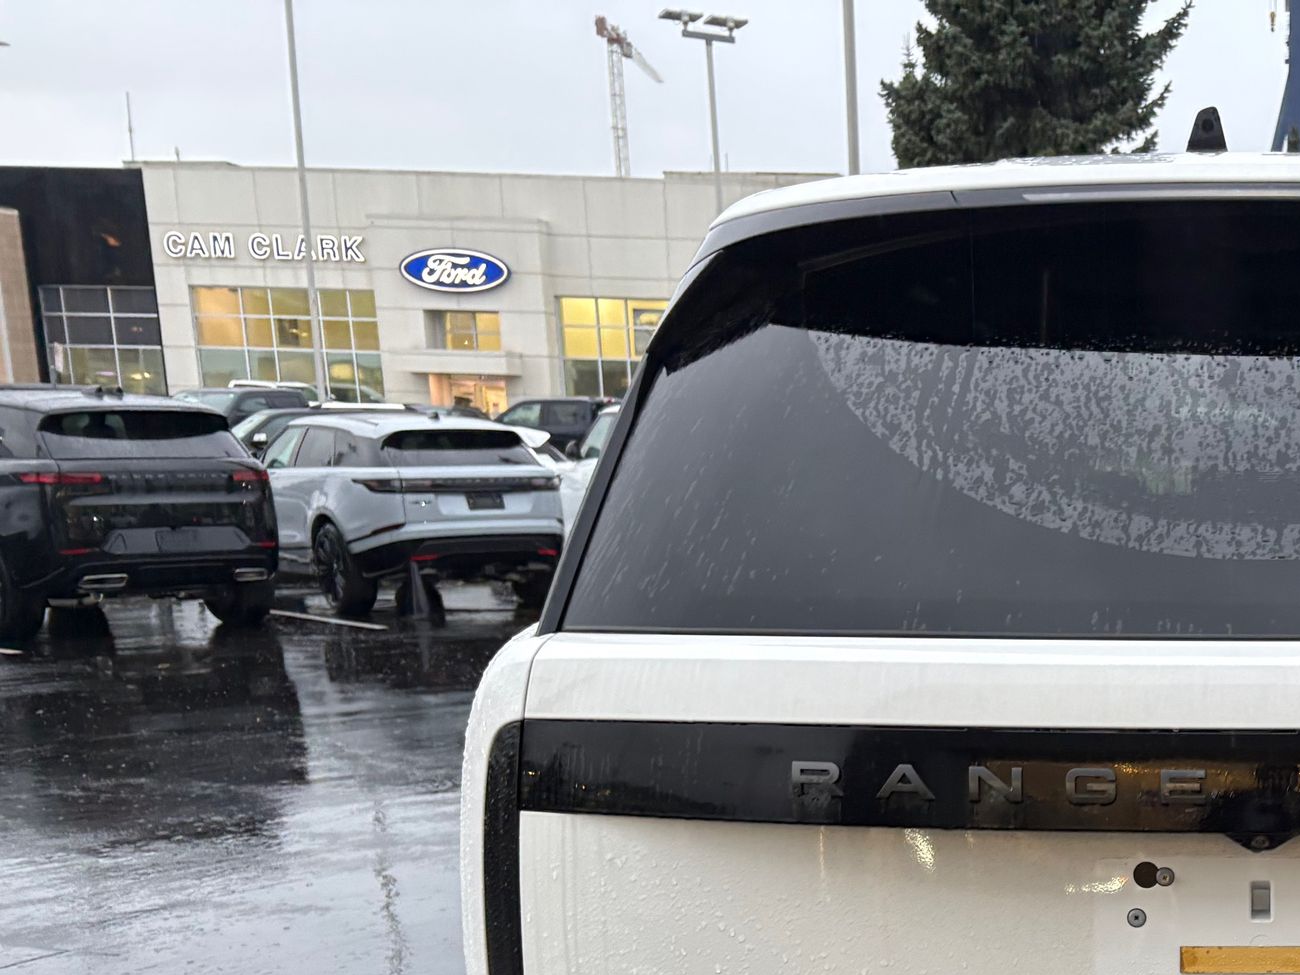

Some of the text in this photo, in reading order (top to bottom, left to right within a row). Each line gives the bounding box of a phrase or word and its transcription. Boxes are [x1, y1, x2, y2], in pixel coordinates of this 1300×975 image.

[163, 231, 366, 263] CAM CLARK
[421, 254, 487, 286] Ford
[791, 760, 1207, 805] RANGE
